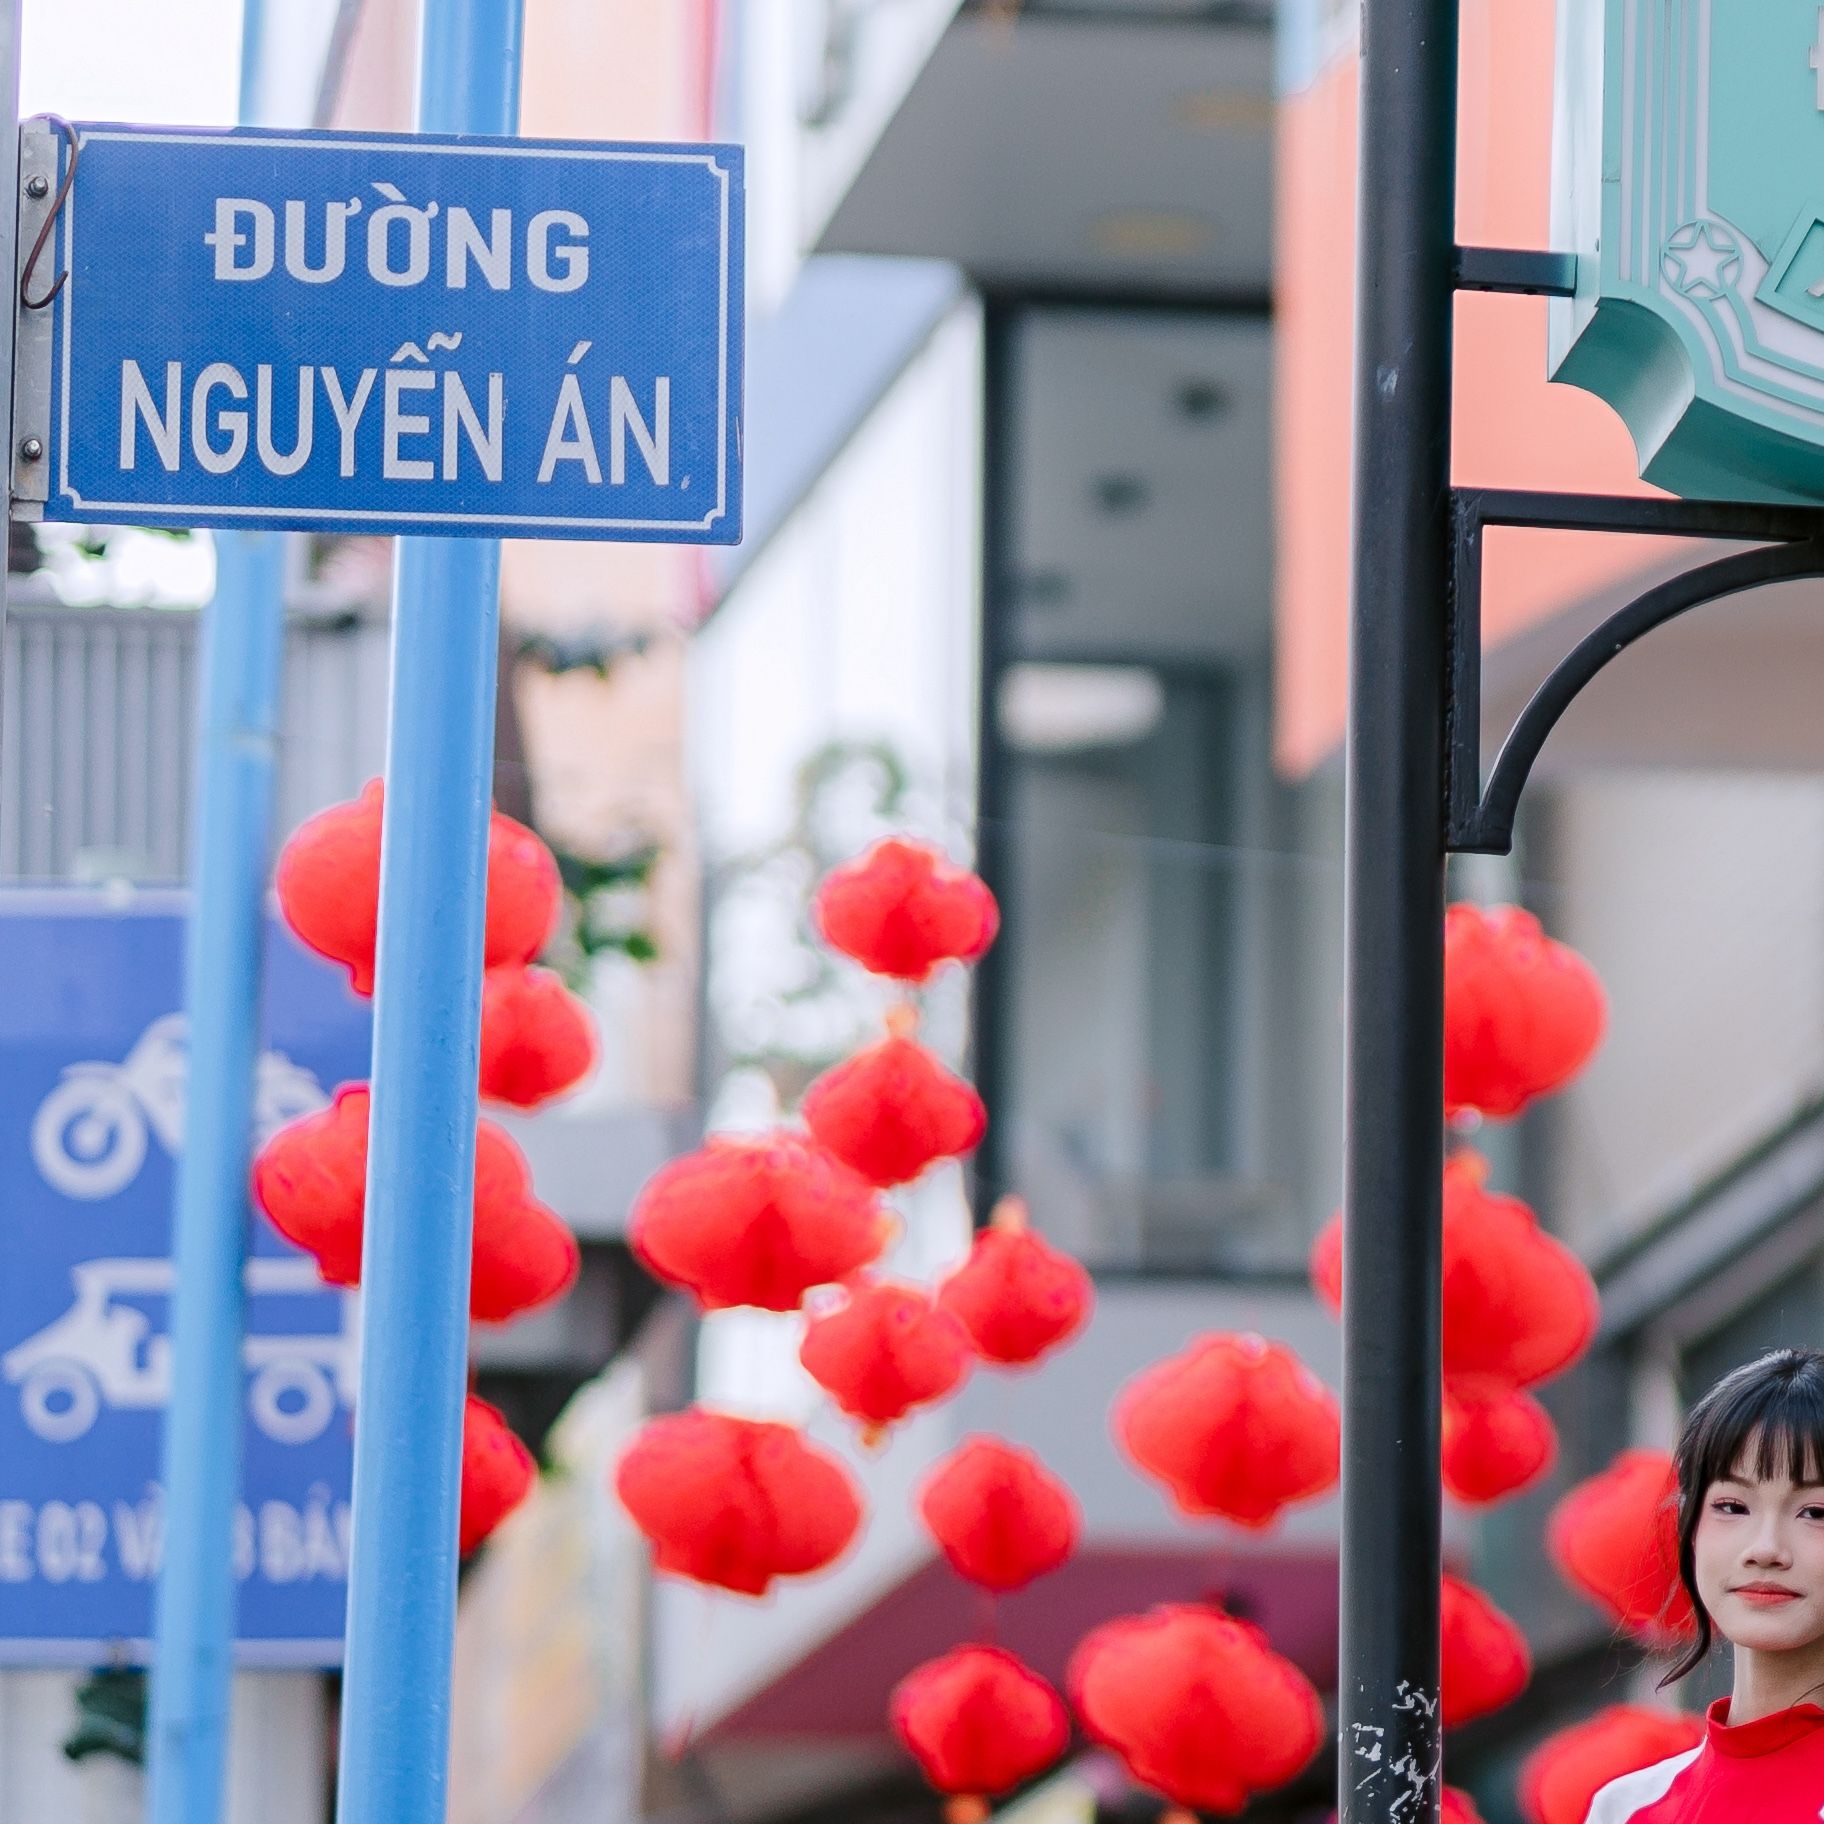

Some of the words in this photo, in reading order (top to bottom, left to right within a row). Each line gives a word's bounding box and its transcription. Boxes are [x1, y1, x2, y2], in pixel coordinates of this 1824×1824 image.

[204, 181, 591, 294] ĐƯỜNG
[118, 331, 503, 482] NGUYỄN
[536, 340, 671, 487] ÁN
